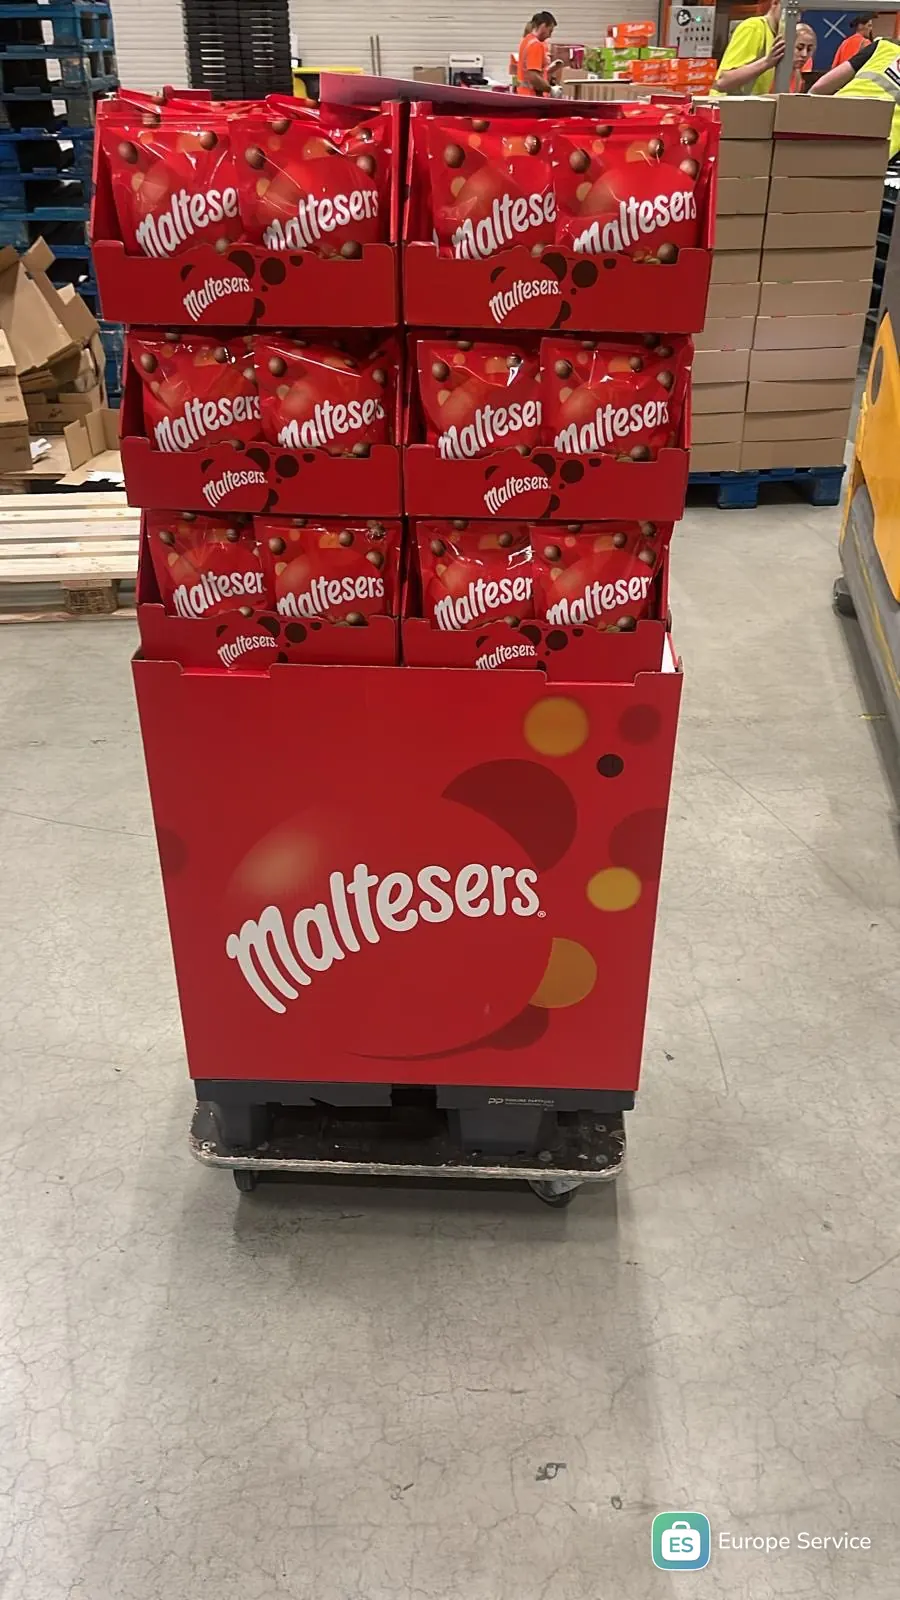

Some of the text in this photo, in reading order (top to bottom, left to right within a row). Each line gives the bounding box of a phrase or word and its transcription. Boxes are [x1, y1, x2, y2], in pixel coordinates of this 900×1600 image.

[135, 187, 239, 258] Maltese
[452, 192, 556, 259] Maltese
[438, 400, 542, 459] Malteser
[172, 571, 266, 619] Malteser
[434, 576, 533, 631] Malteser
[546, 576, 652, 625] Malteser
